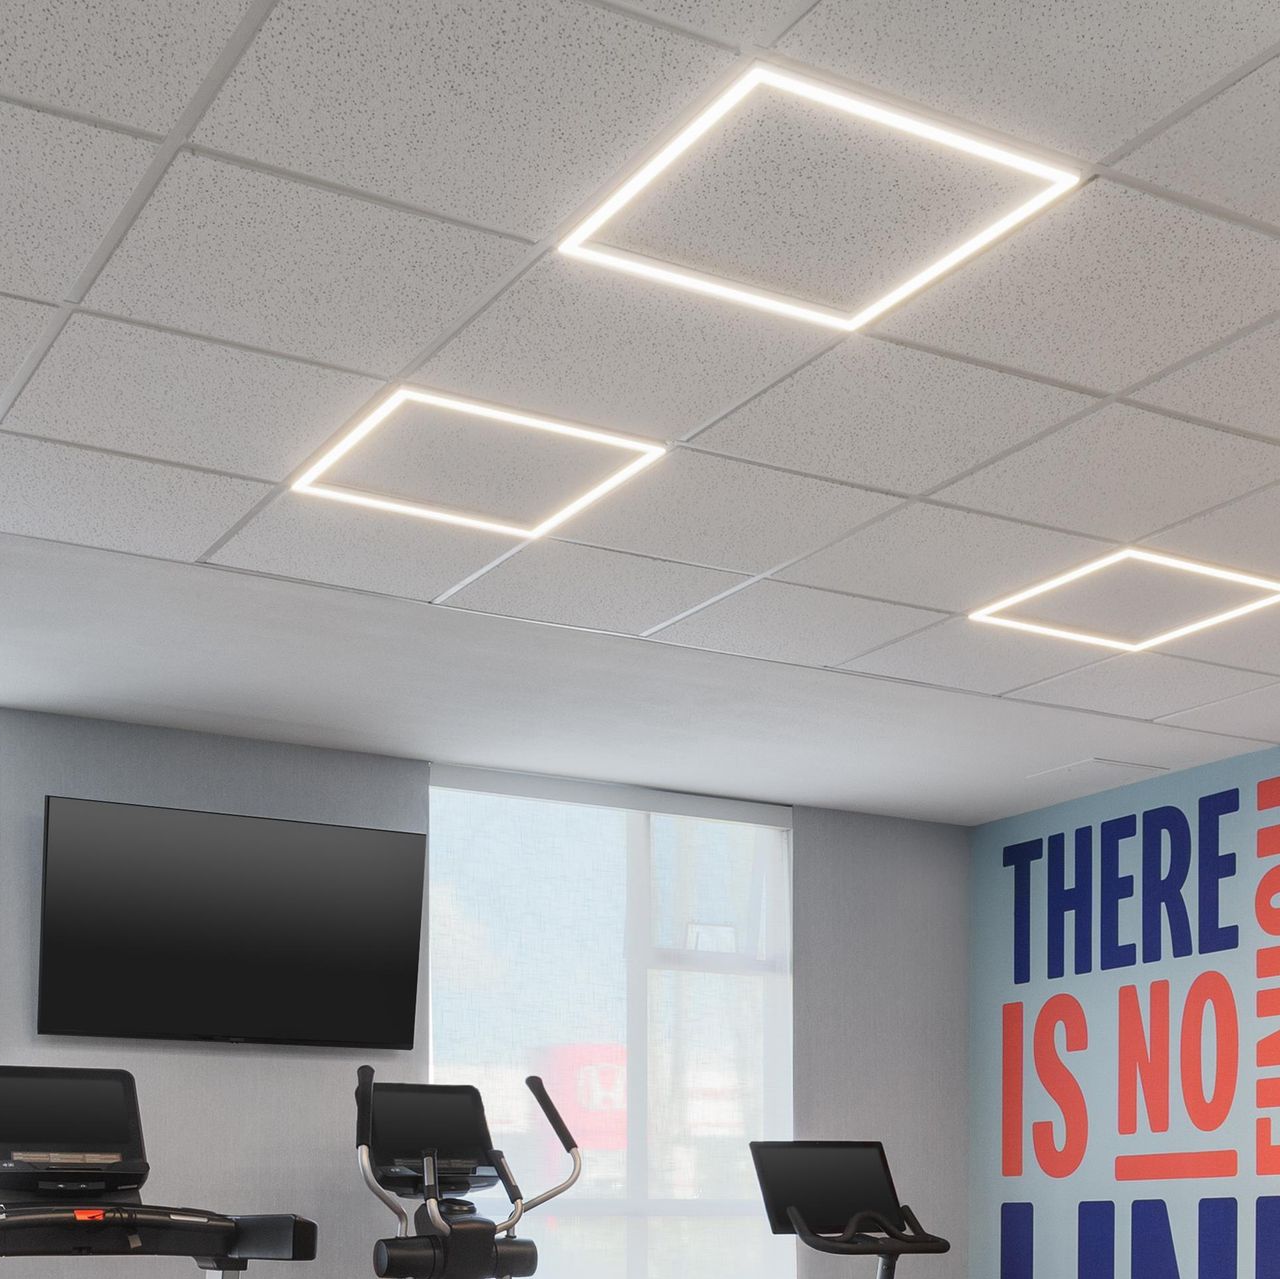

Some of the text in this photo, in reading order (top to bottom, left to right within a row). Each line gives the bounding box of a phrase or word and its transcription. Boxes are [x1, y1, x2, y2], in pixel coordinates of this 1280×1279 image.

[1002, 788, 1240, 984] THERE
[1001, 970, 1239, 1179] IS NO
